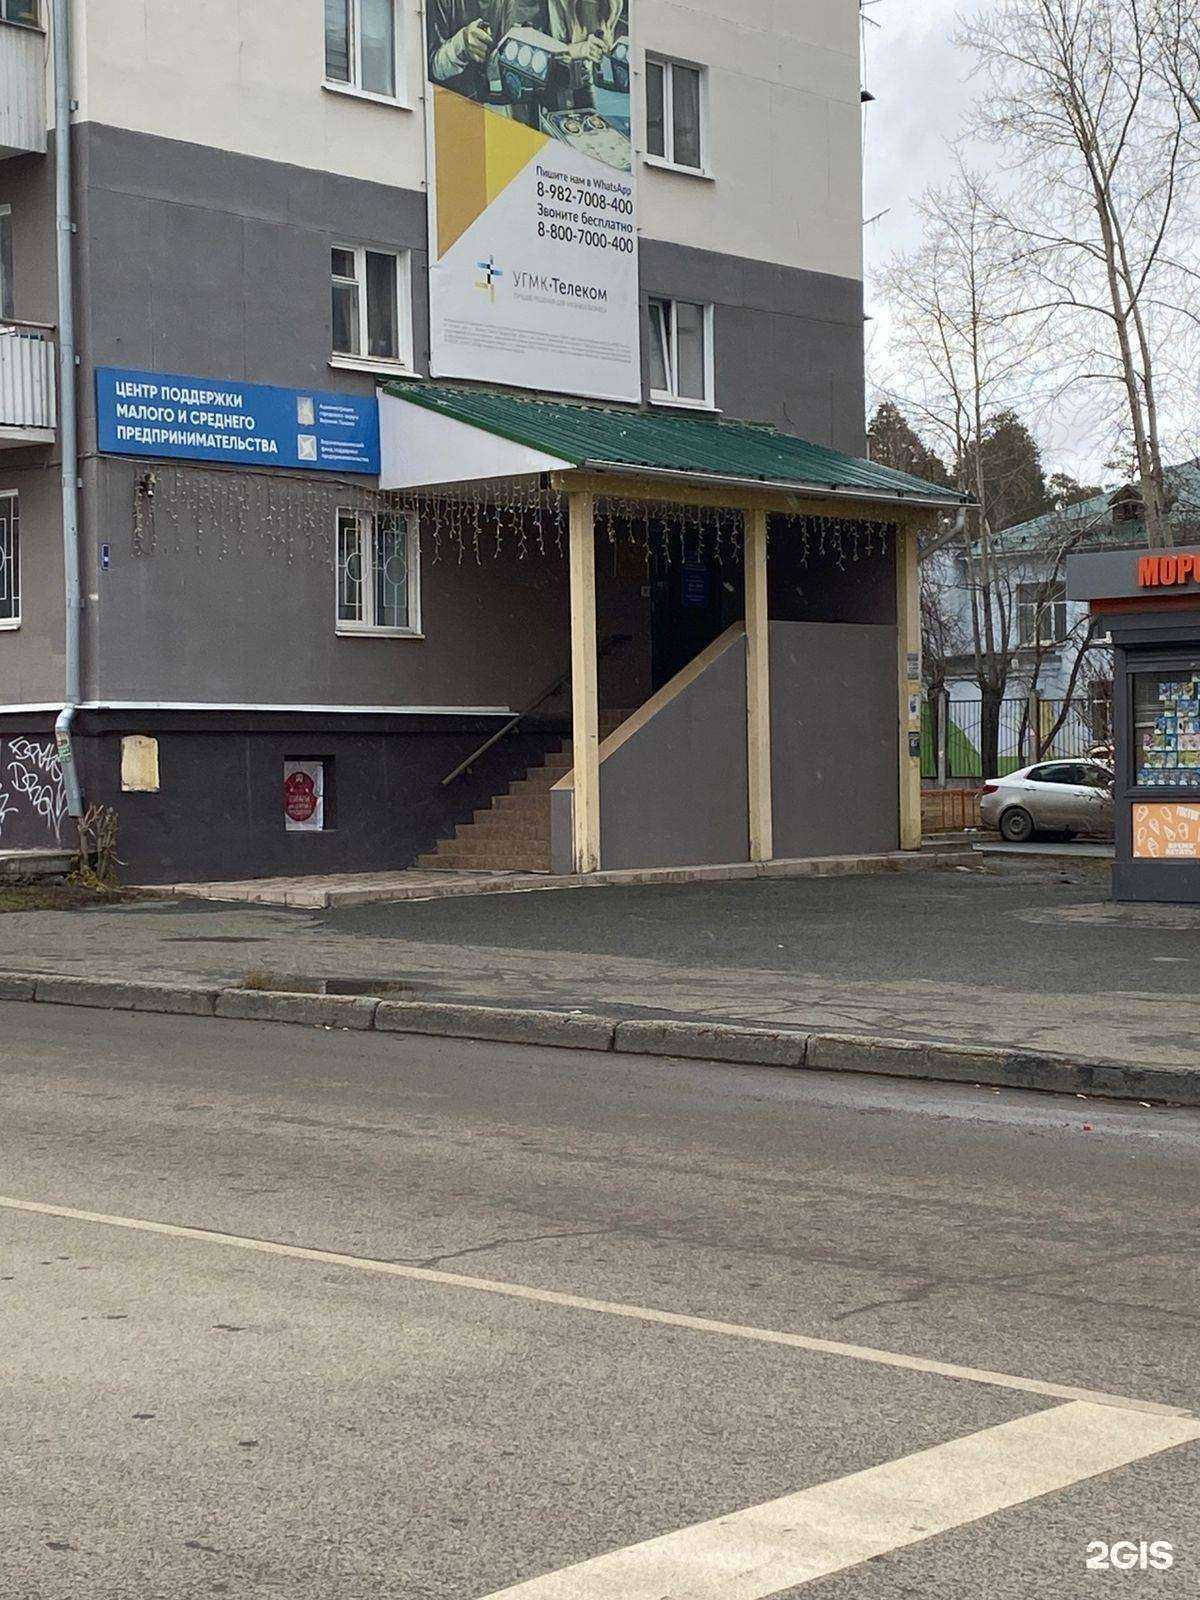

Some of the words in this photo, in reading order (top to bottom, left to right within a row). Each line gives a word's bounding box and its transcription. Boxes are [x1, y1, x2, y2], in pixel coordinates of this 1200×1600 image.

[536, 165, 568, 182] Пишите
[570, 175, 585, 185] нам
[593, 179, 632, 197] WhatsApp
[537, 181, 633, 215] 8-982-7008-400
[537, 203, 579, 223] Звоните
[581, 212, 633, 233] бесплатно
[538, 221, 634, 253] 8-800-7000-400
[115, 381, 158, 398] ЦЕНТР
[161, 386, 243, 408] ПОДДЕРЖКИ
[116, 404, 175, 423] МАЛОГО
[178, 411, 187, 424] И
[190, 411, 256, 430] СРЕДНЕГО
[117, 425, 279, 453] ПРЕДПРИНИМАТЕЛЬСТВА
